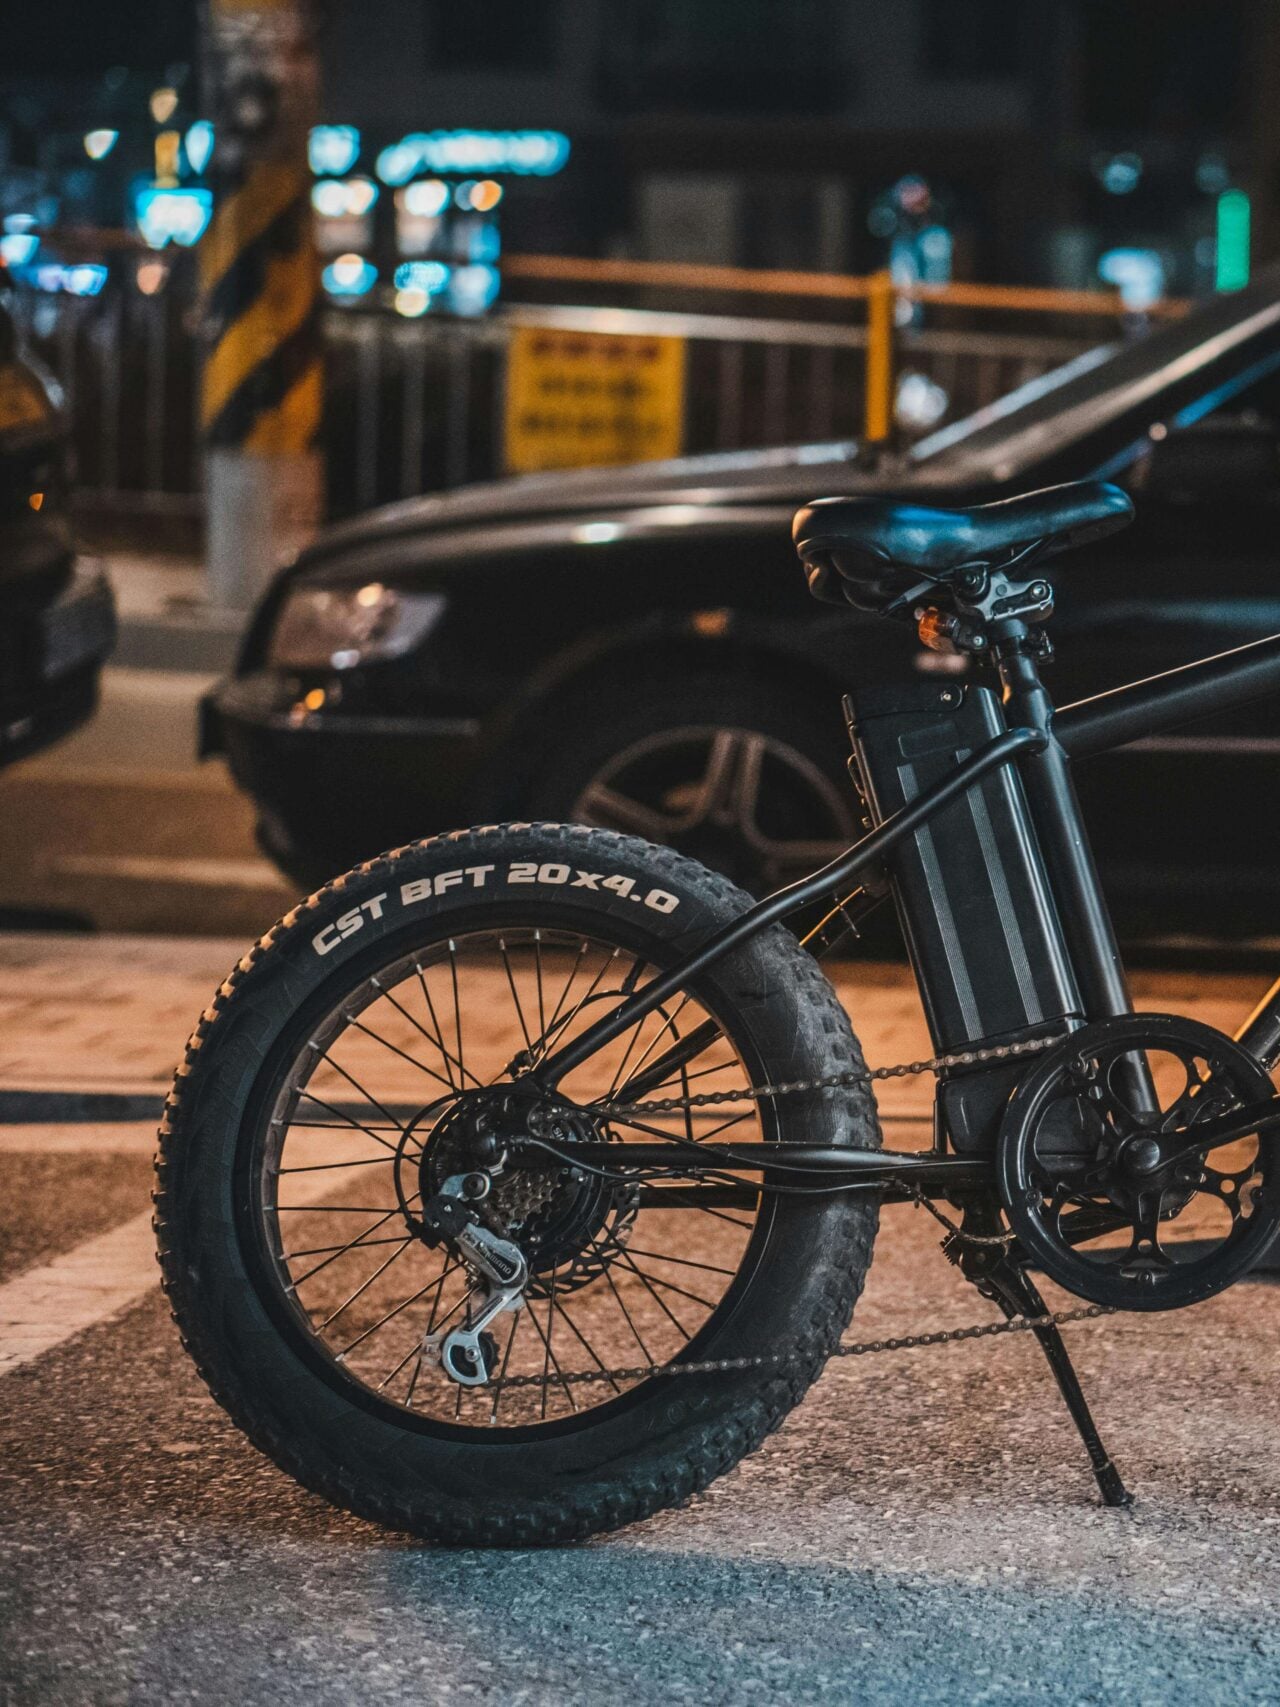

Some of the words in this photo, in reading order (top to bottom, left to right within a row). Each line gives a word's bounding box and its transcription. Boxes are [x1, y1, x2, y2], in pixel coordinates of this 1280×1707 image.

[311, 893, 388, 956] CST
[400, 865, 495, 906] BFT
[507, 862, 680, 914] 20x4.0
